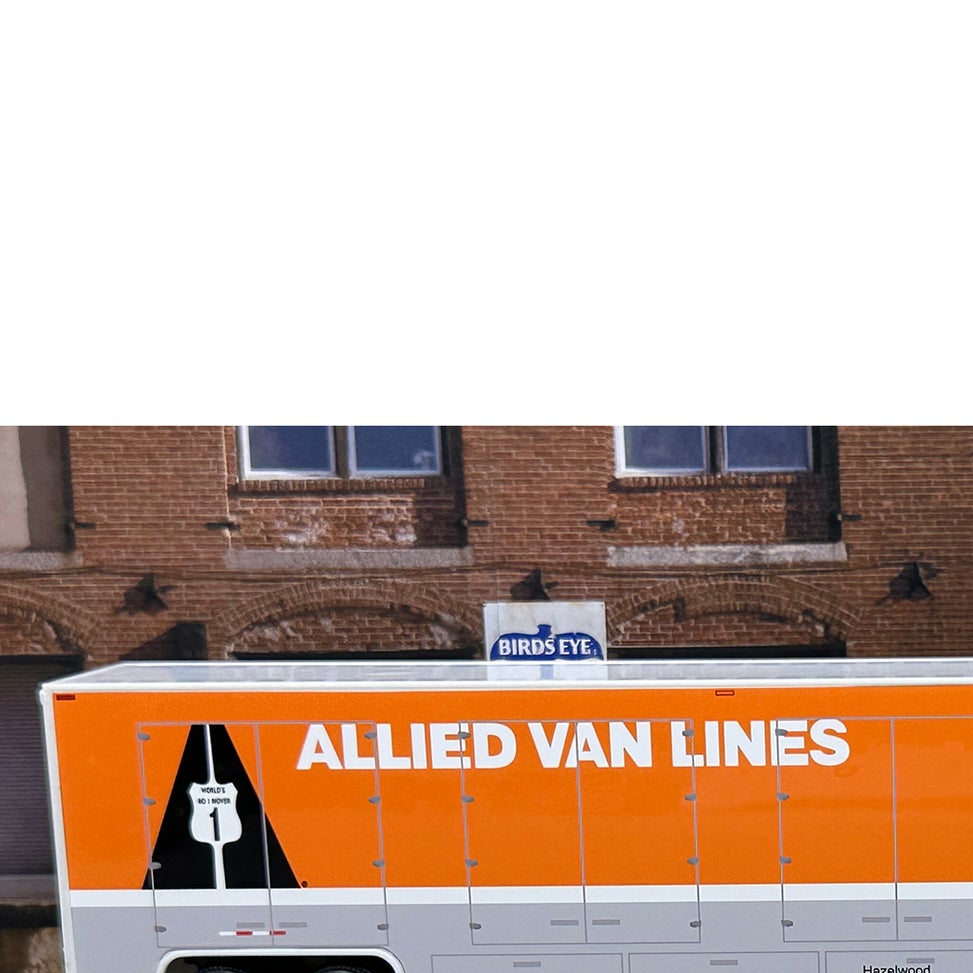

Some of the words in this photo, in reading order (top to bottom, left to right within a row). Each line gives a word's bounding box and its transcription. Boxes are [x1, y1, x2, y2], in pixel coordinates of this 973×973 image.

[559, 638, 591, 655] EYE
[296, 723, 517, 770] ALLIED
[527, 721, 653, 768] VAN
[670, 718, 850, 767] LINES
[209, 807, 221, 842] 1
